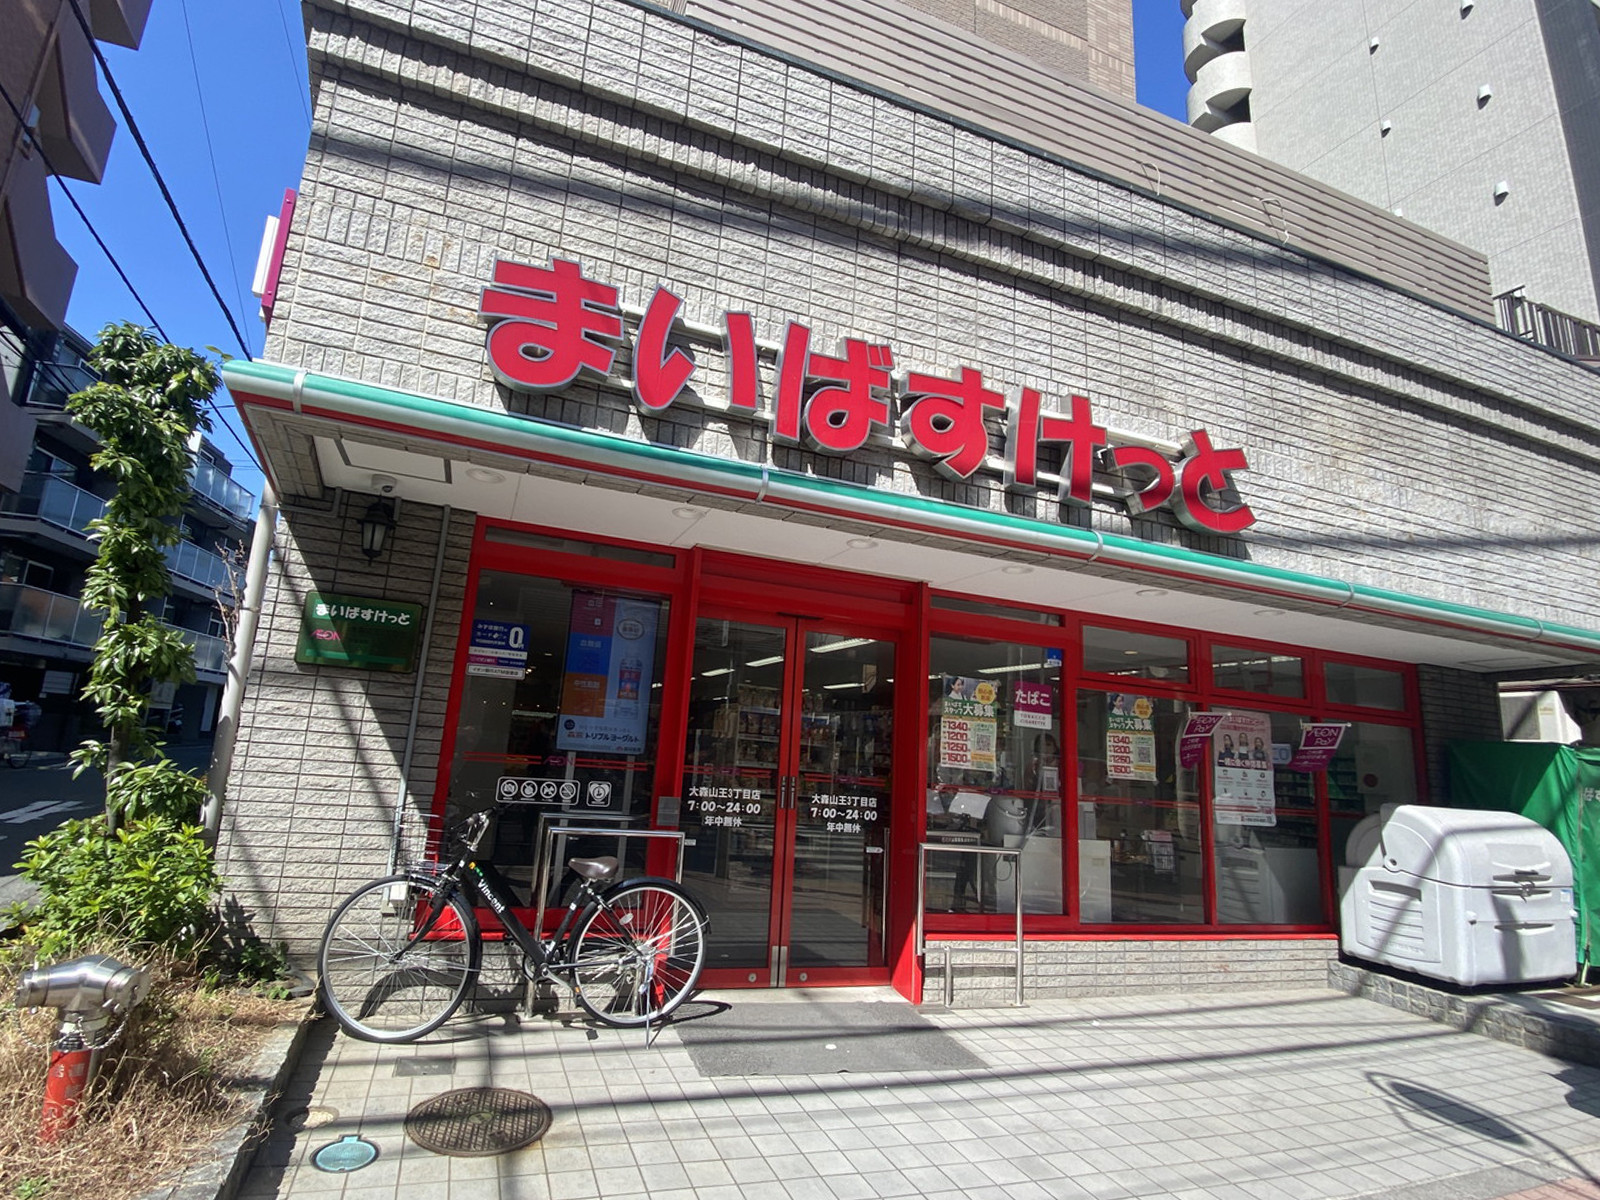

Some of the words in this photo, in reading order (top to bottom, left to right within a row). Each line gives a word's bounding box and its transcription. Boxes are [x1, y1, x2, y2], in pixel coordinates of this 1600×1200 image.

[479, 257, 1257, 534] まいばすけっと
[315, 603, 411, 625] まいばすけっと
[1015, 689, 1051, 707] たばこ
[963, 703, 995, 718] 大募集
[1125, 718, 1152, 731] 大募集
[1307, 727, 1340, 738] AEON
[688, 786, 761, 801] 大森山王3丁目店
[811, 793, 878, 808] 大森山王3丁目店
[704, 815, 743, 828] 年中無休
[826, 821, 862, 834] 年中無休
